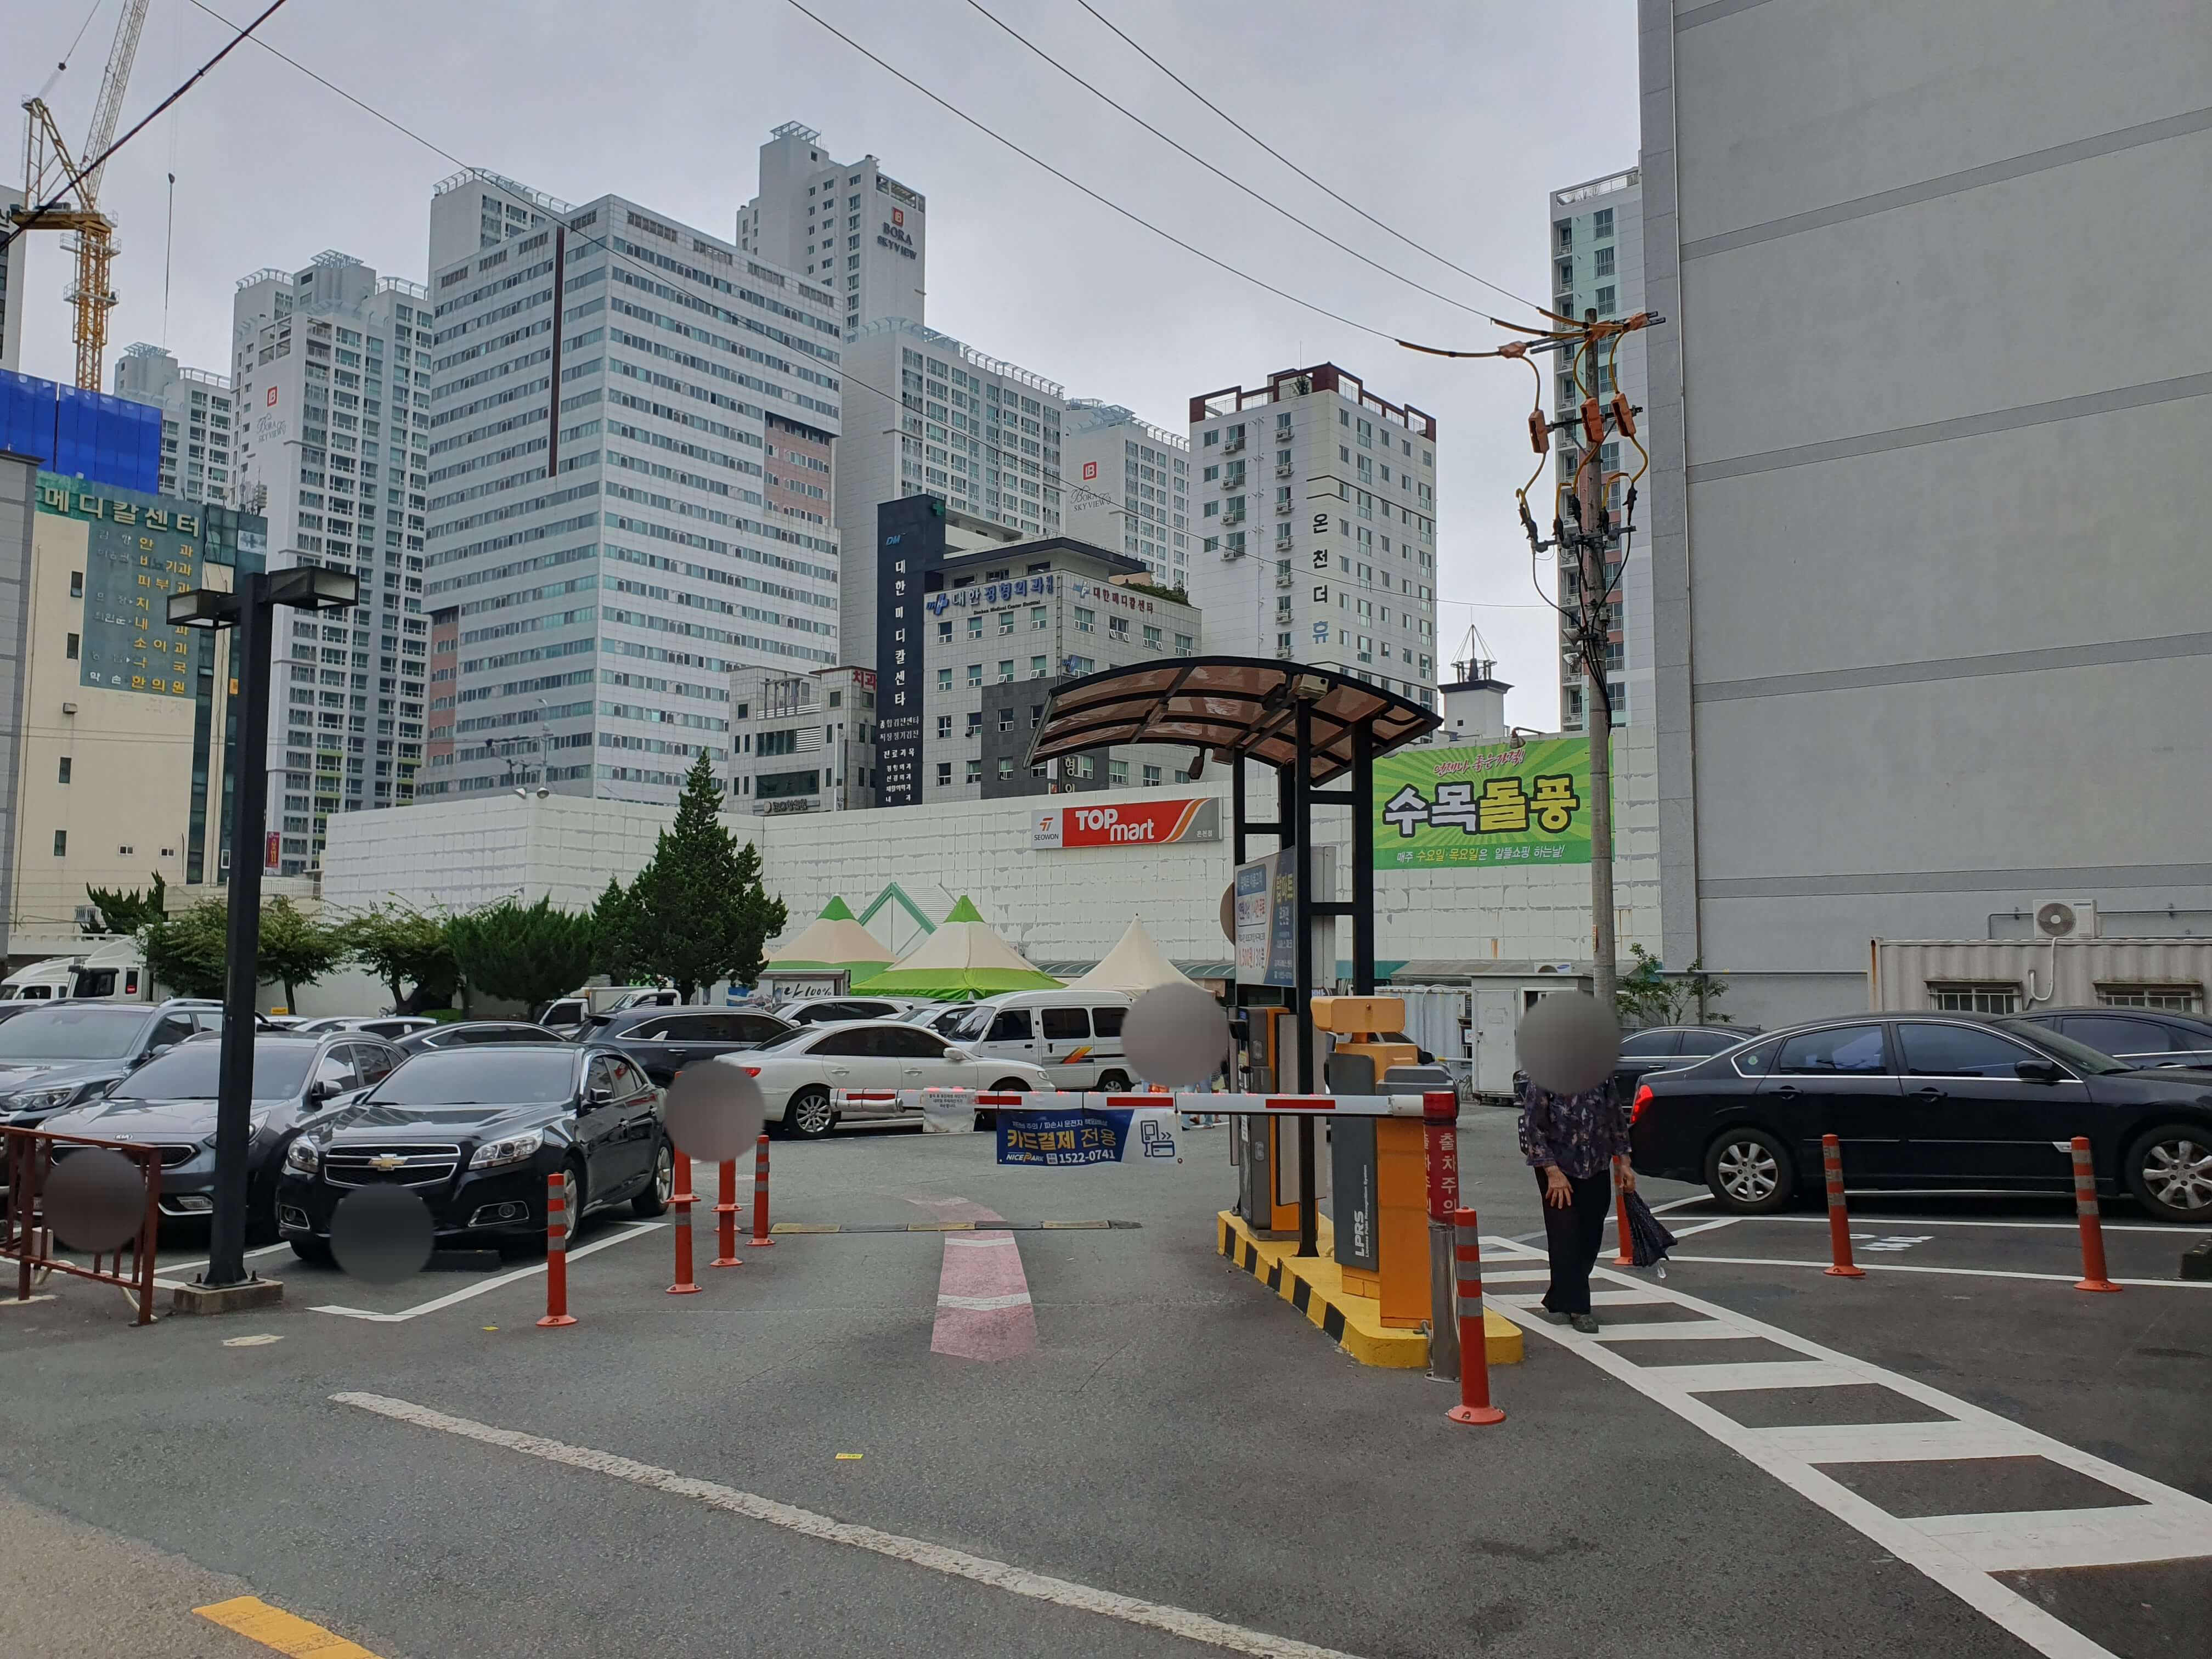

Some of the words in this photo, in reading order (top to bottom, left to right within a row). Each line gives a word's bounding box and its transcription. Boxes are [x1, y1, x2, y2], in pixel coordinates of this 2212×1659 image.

[883, 222, 912, 245] BORA
[44, 487, 199, 537] 메디칼센터
[1074, 500, 1105, 511] SKYVIEW
[132, 675, 184, 694] 한의원
[853, 670, 876, 691] 치과
[1383, 775, 1579, 837] 수목돌풍
[1075, 808, 1118, 831] TOP
[1110, 819, 1154, 841] mart
[1397, 850, 1413, 863] 매주
[1494, 846, 1531, 860] 알뜰쇼핑
[805, 986, 832, 997] 100%
[1064, 1119, 1084, 1127] 운전자
[1007, 1129, 1076, 1150] 카드결제
[1080, 1127, 1116, 1148] 전용
[1059, 1150, 1115, 1164] 1522-0741
[1440, 1132, 1457, 1214] 출차주의
[1354, 1210, 1364, 1257] LPRS
